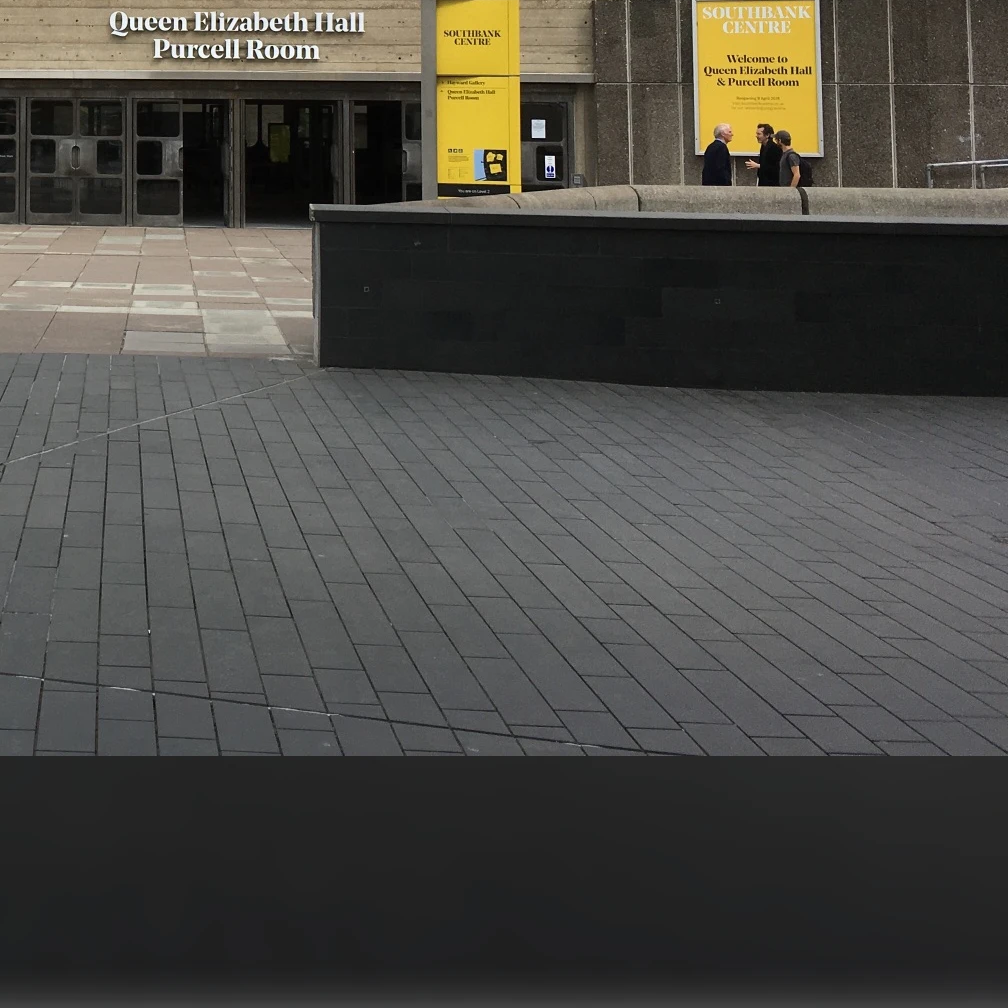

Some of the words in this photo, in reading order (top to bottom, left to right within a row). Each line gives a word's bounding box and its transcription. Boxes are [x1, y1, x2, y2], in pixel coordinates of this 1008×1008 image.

[702, 6, 811, 19] SOUTHBANK
[109, 11, 187, 37] Queen
[193, 11, 309, 32] Elizabeth
[314, 12, 365, 33] Hall
[722, 21, 791, 34] CENTRE
[153, 38, 240, 59] Purcell
[246, 39, 320, 60] Room
[727, 55, 775, 63] Welcome
[777, 55, 788, 63] to
[704, 66, 737, 76] Queen
[739, 66, 788, 74] Elizabeth
[790, 66, 812, 74] Hall
[717, 77, 725, 86] &
[728, 77, 765, 86] Purcell
[767, 77, 799, 86] Room
